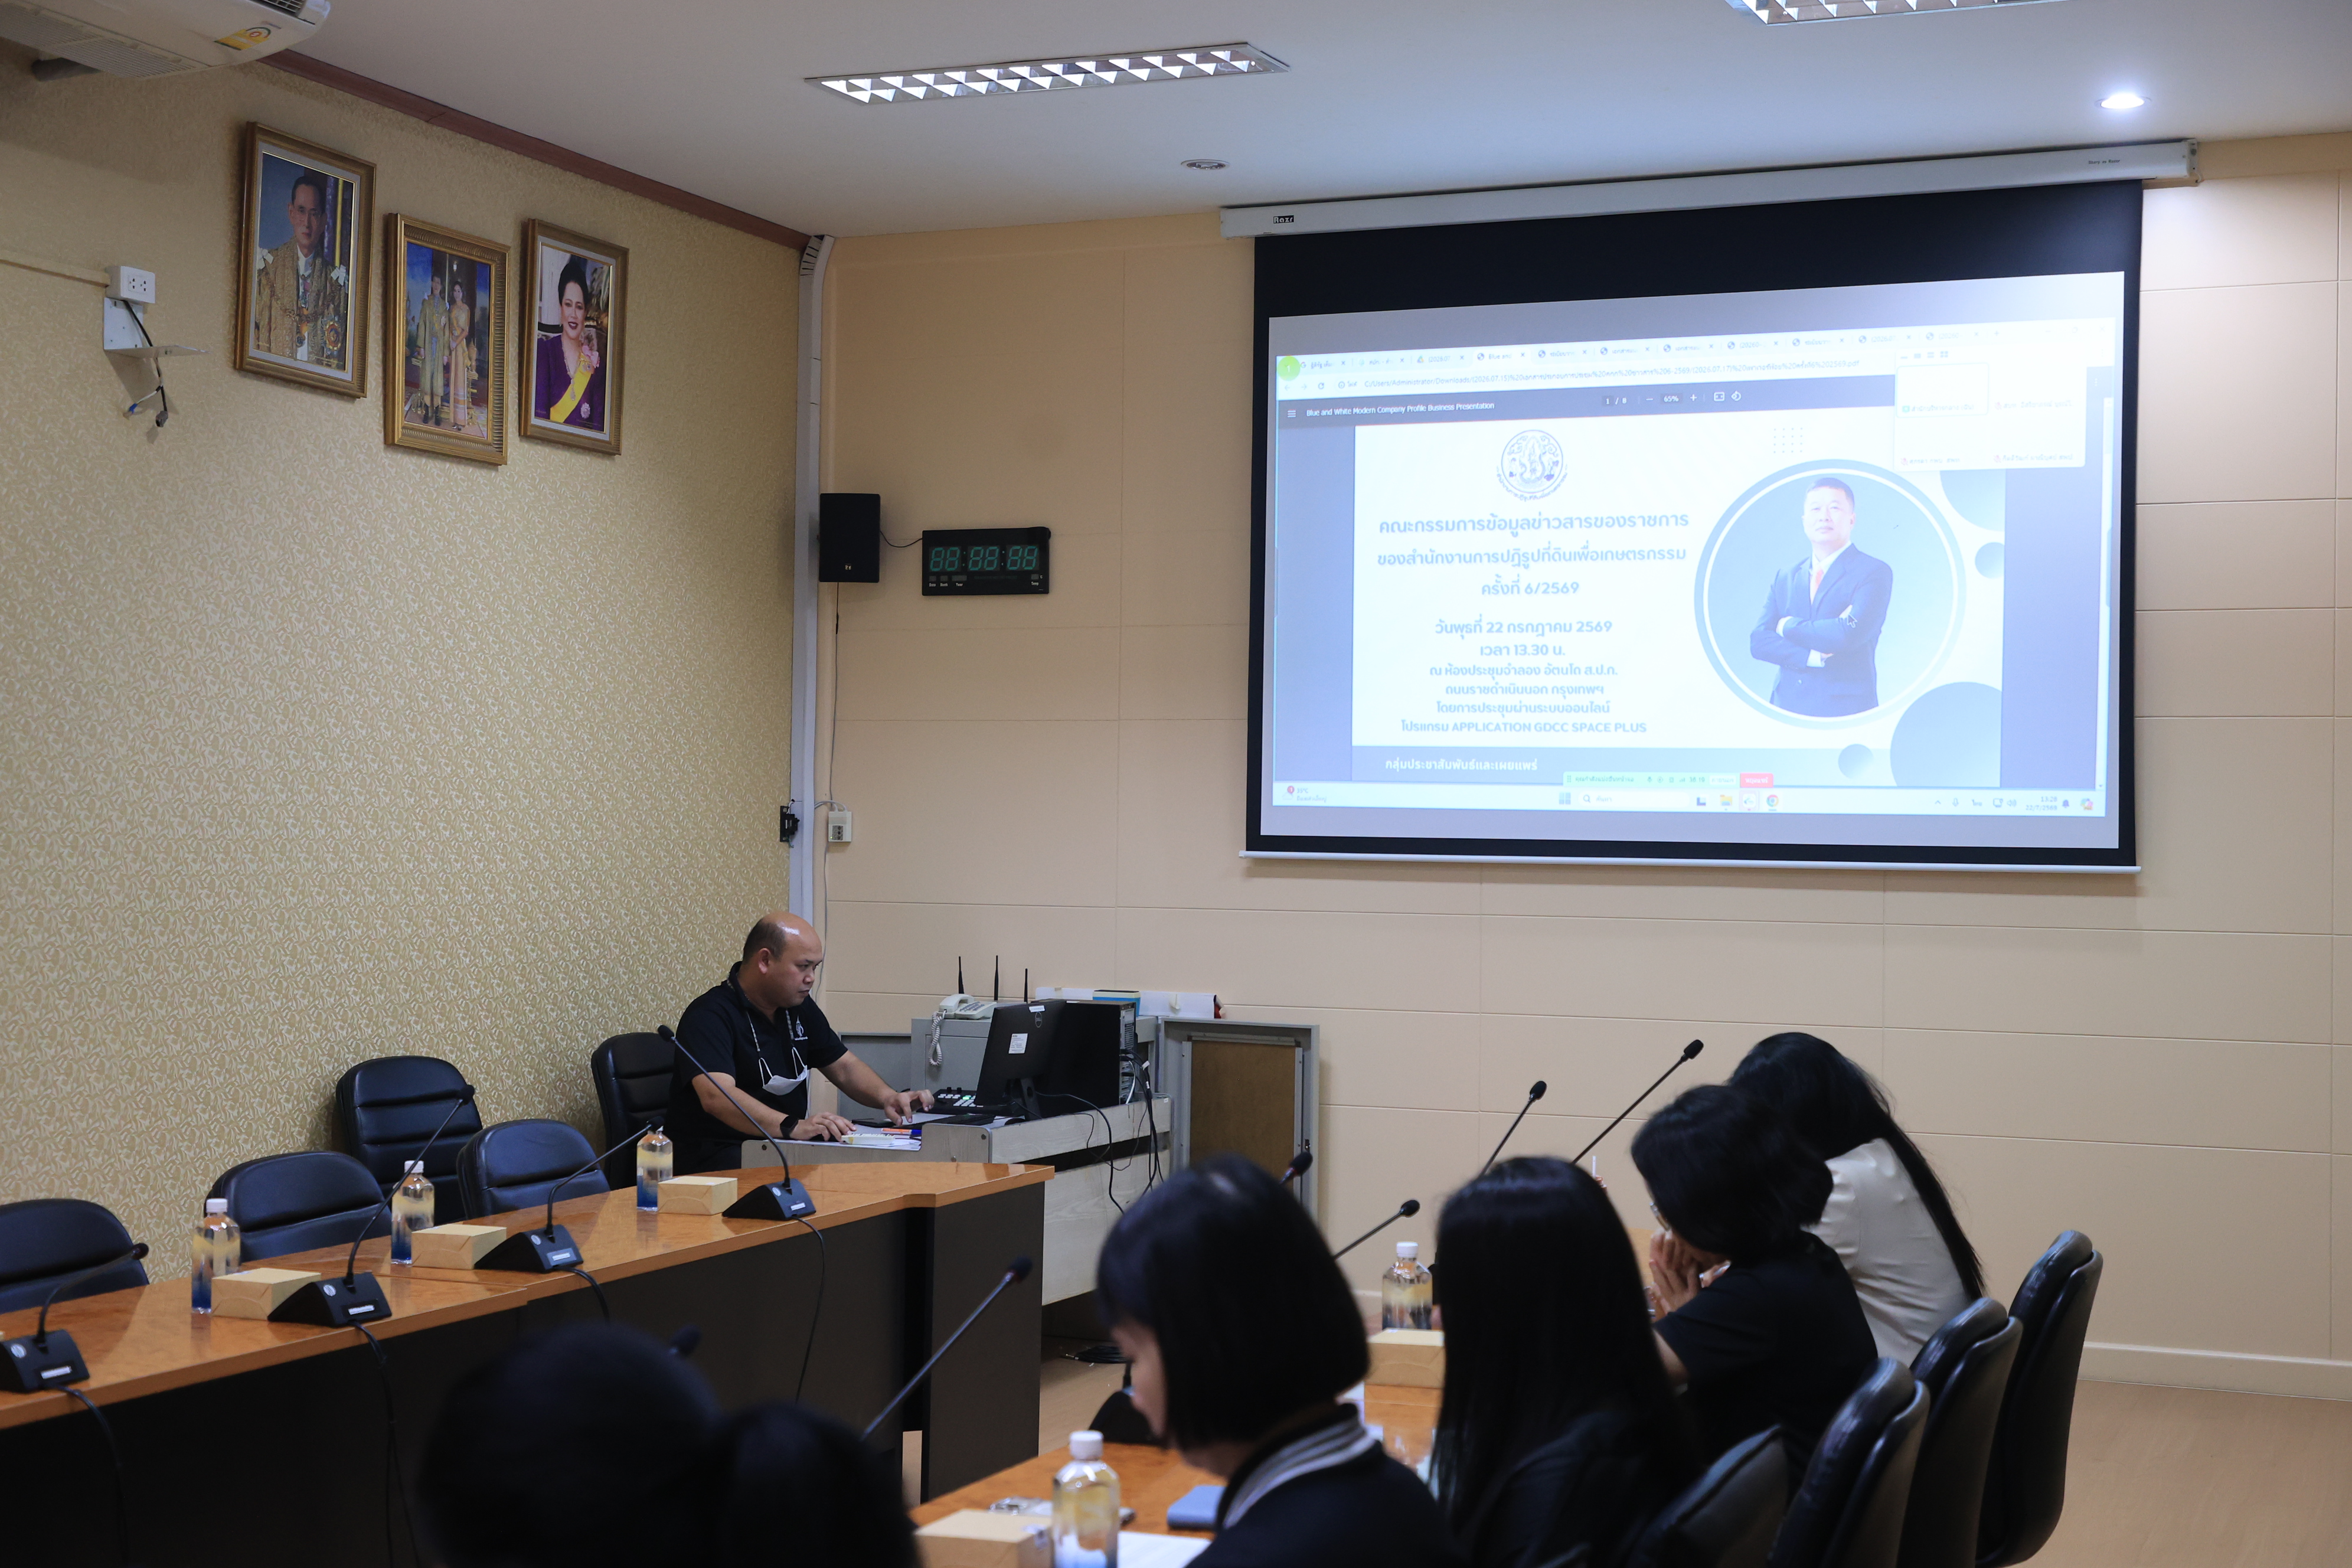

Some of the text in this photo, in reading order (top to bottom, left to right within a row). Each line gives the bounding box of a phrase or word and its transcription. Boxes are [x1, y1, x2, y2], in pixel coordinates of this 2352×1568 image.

[1377, 406, 1406, 415] Company
[1407, 404, 1427, 413] Profile
[1427, 403, 1455, 411] Business
[1456, 402, 1495, 410] Presentation
[1379, 512, 1689, 537] คณะกรรมการข้อมูลข่าวสารของราชการ
[1377, 540, 1686, 569] ของสำนักงานการปฏิรูปที่ดินเพื่อเกษตรกรรม
[1481, 574, 1579, 596] ครั้งที่ 6/2569
[1435, 613, 1612, 640] วันพุธที่ 22 กรกฎาคม 2569
[1480, 644, 1566, 656] เวลา 13.30 น.
[1430, 665, 1442, 675] ณ
[1445, 662, 1541, 681] ห้องประชุมจำลอง
[1584, 664, 1618, 675] ส.ป.ก.
[1445, 682, 1604, 700] ถนนราชดำเนินนอก กรุงเทพฯ
[1436, 700, 1611, 718] โดยการประชุมผ่านระบบออนไลน์
[1401, 719, 1647, 733] โปรแกรม APPLICATION GDCC SPACE PLUS
[1385, 757, 1538, 773] กลุ่มประชาสัมพันธ์และเผยแพร่
